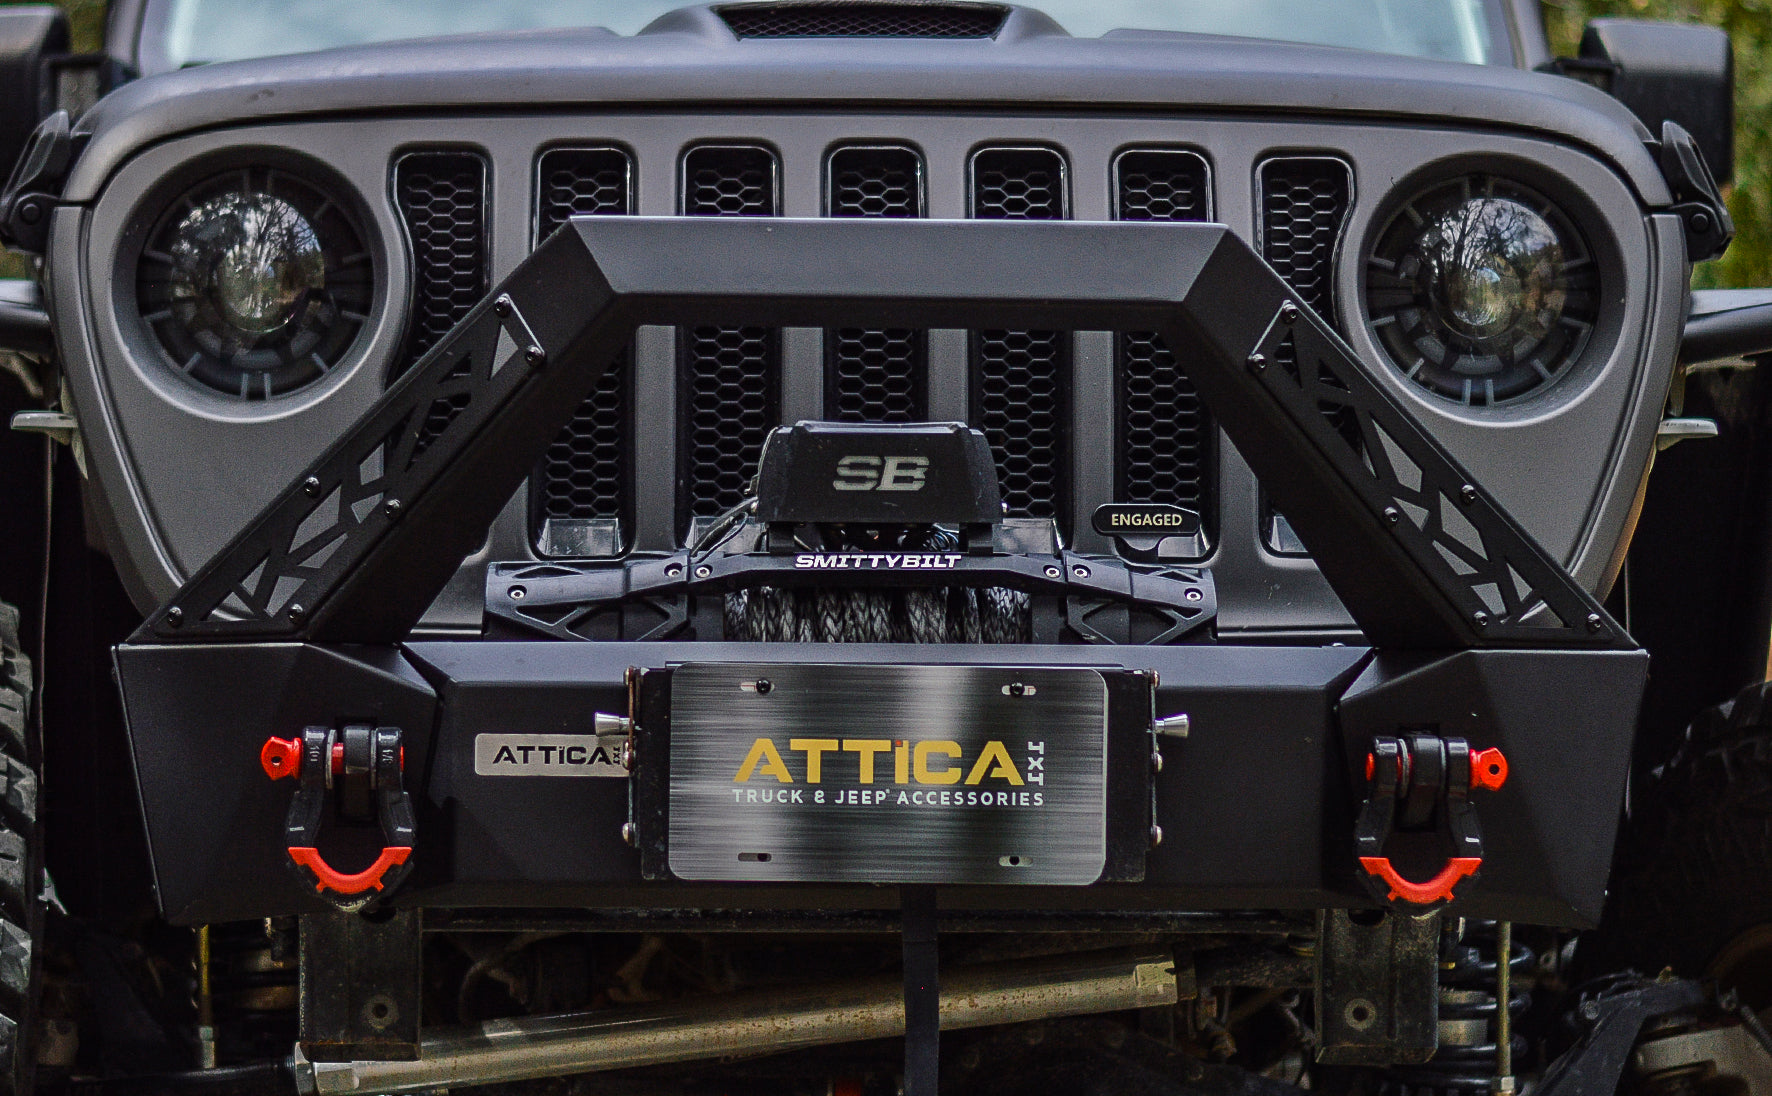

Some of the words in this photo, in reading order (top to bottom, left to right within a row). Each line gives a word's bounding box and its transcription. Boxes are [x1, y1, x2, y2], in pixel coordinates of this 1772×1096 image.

[833, 455, 930, 491] SB
[1111, 513, 1183, 526] ENGAGED
[795, 554, 962, 568] SMITTYBILT
[732, 789, 803, 803] TRUCK
[814, 790, 825, 803] &
[897, 791, 1044, 806] ACCESSORIES
